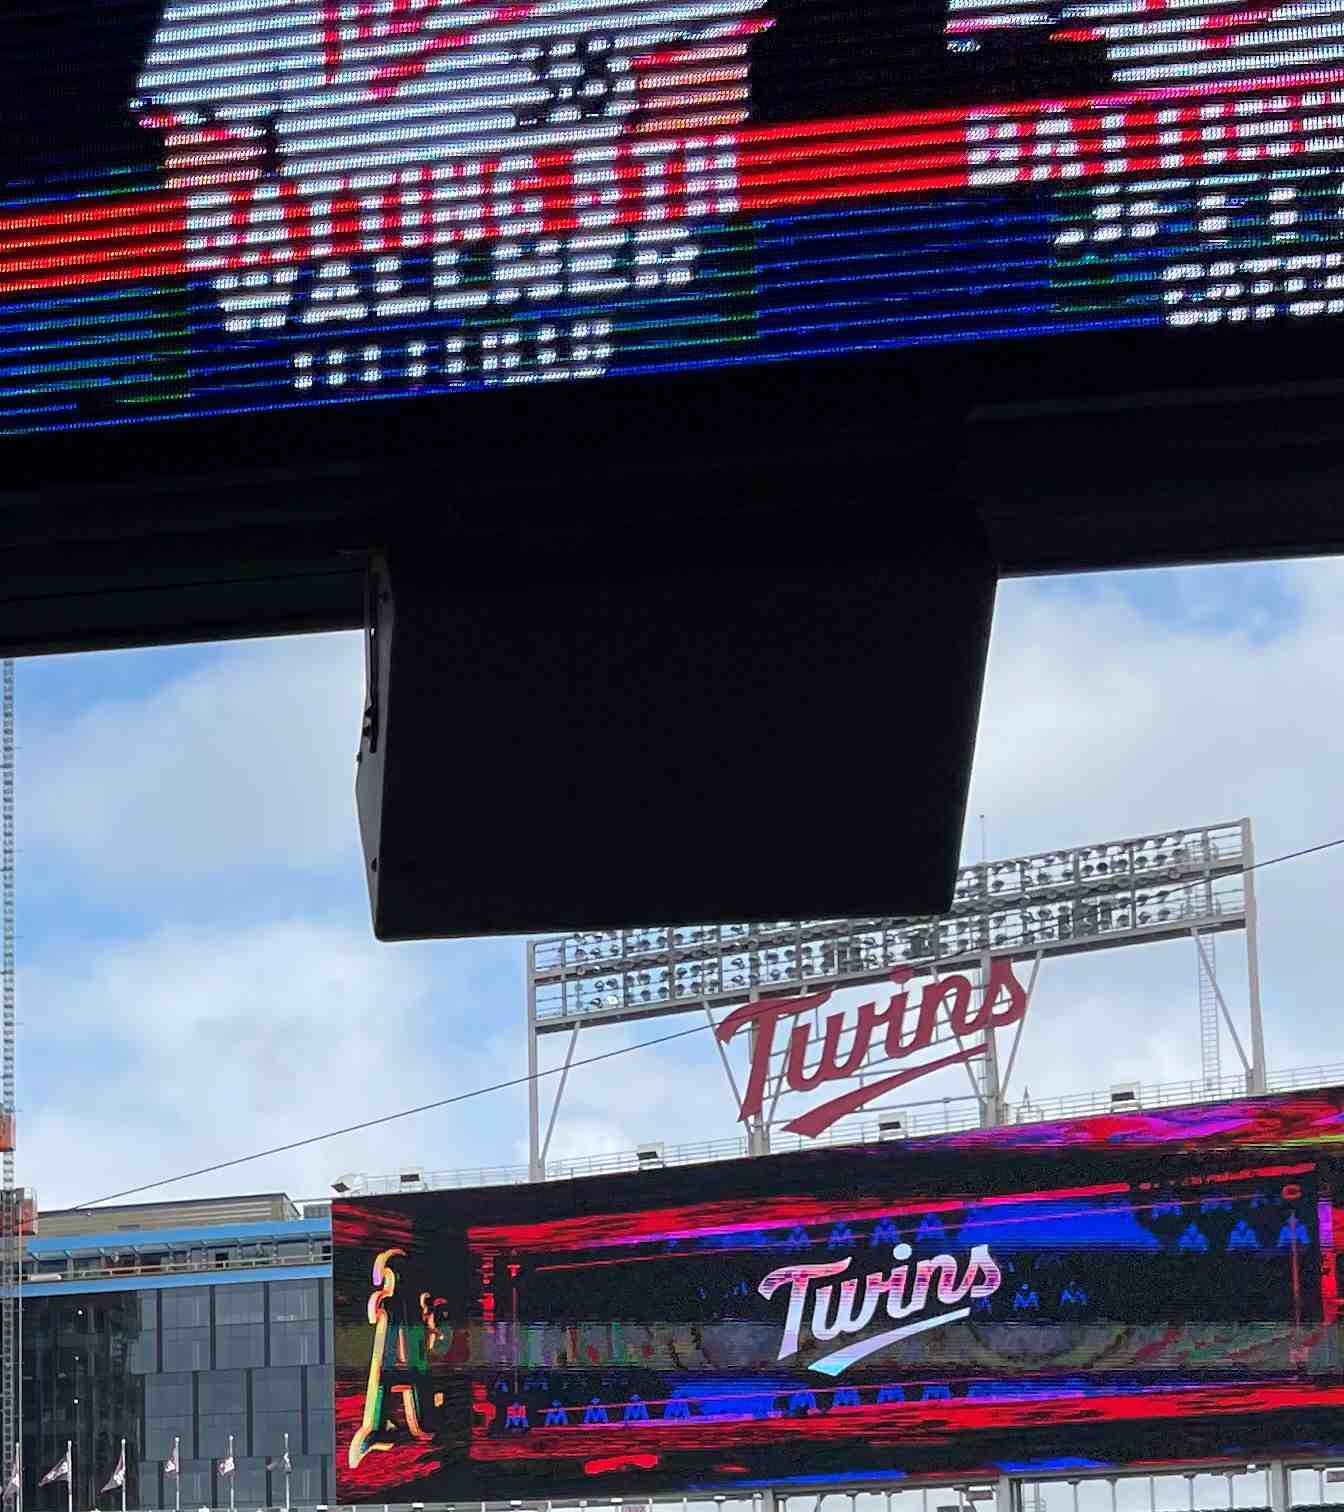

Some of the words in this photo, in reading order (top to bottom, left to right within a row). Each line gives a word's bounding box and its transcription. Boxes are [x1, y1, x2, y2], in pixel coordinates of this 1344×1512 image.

[213, 222, 700, 337] WALLNER
[714, 957, 1027, 1139] Twins
[758, 1242, 1000, 1376] Twins
